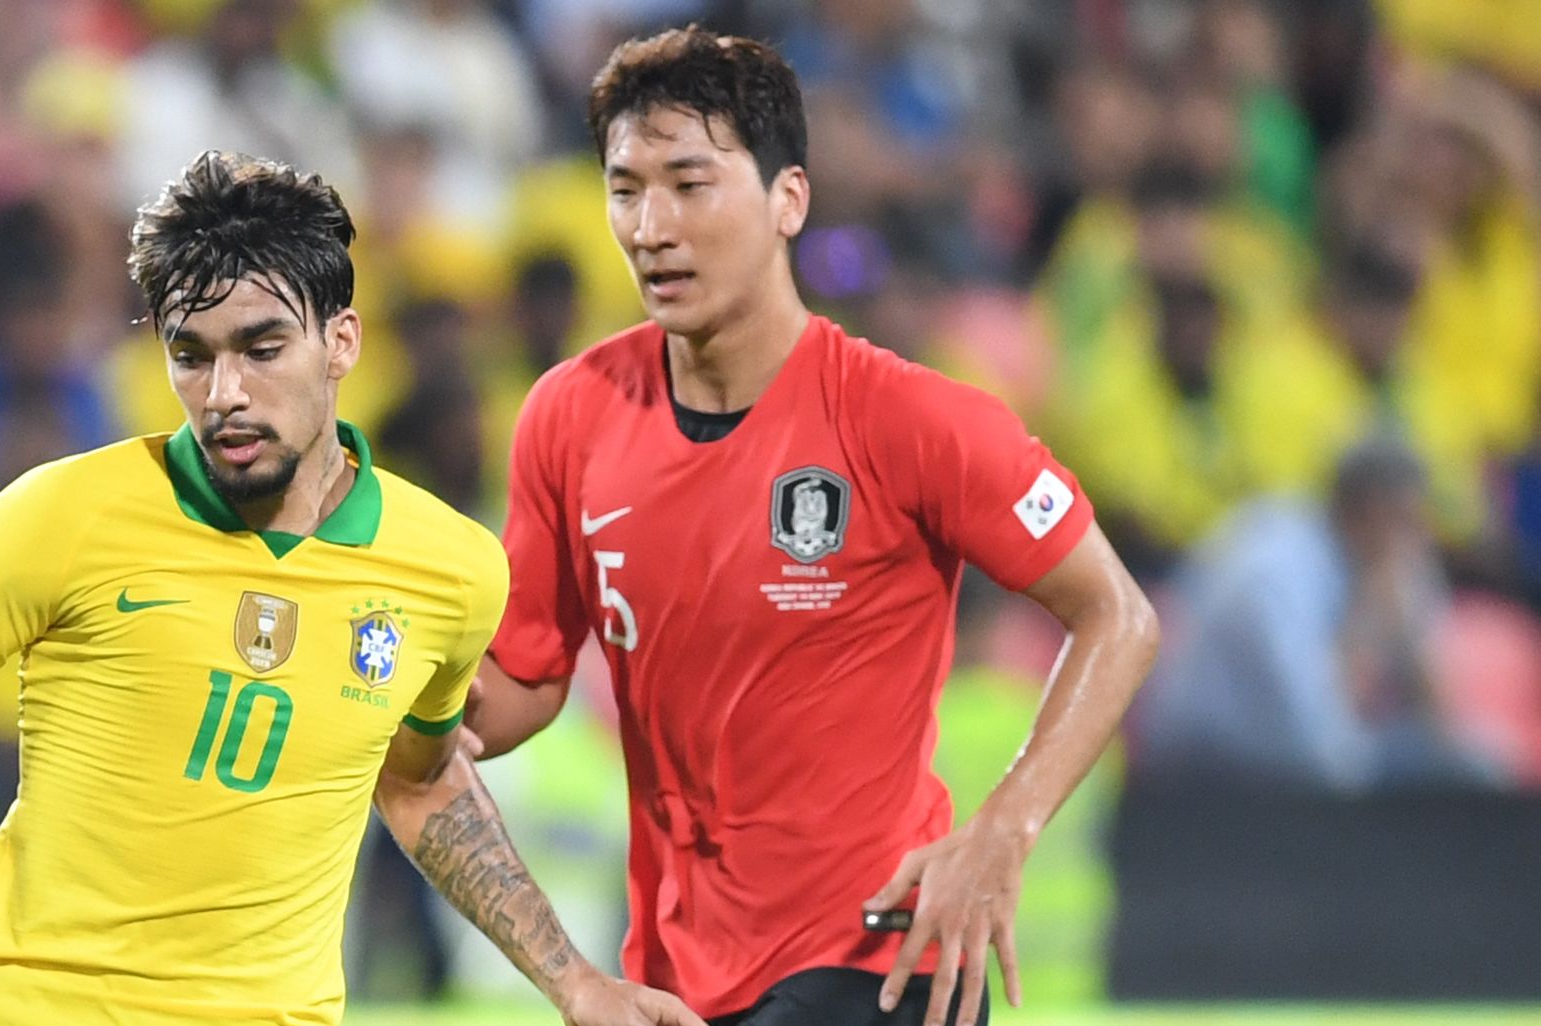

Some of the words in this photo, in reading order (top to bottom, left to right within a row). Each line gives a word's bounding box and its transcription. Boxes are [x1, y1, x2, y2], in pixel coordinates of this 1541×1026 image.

[592, 550, 639, 652] 5
[184, 668, 294, 793] 10
[340, 685, 391, 708] BRASIL
